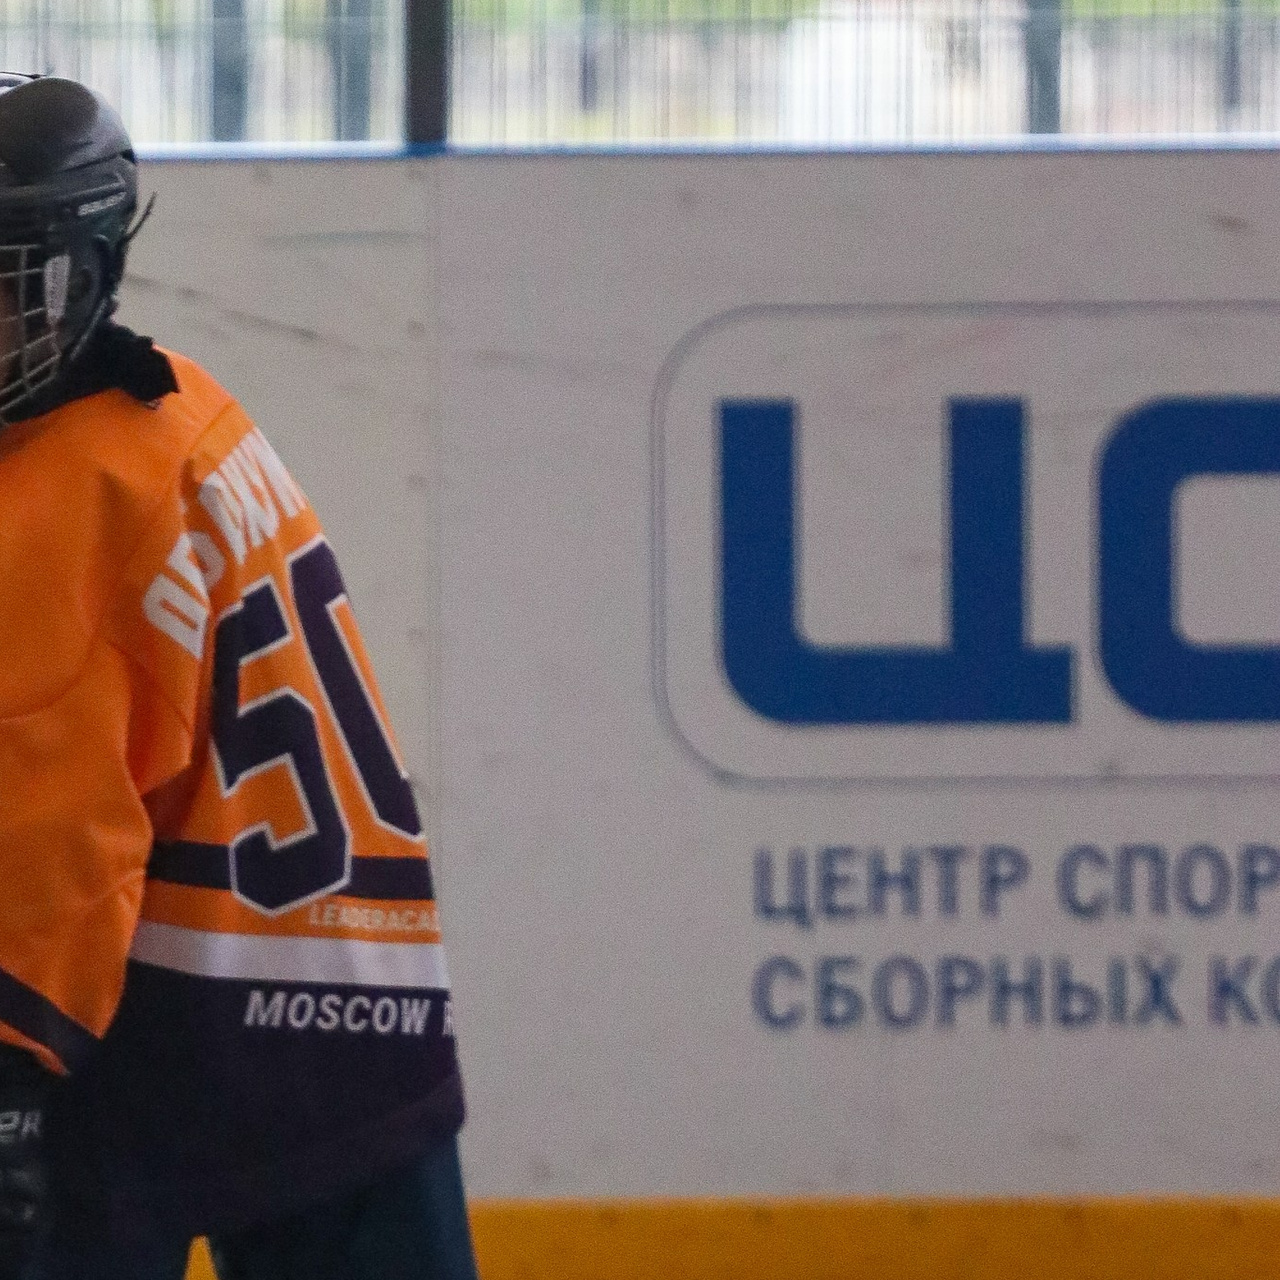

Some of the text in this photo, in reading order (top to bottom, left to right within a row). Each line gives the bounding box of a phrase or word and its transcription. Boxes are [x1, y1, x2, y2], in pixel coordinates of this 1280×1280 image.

[210, 534, 425, 918] 50
[752, 842, 1280, 930] ЦЕНТР СПОР
[243, 990, 431, 1035] MOSCOW
[751, 954, 1182, 1031] СБОРНЫХ
